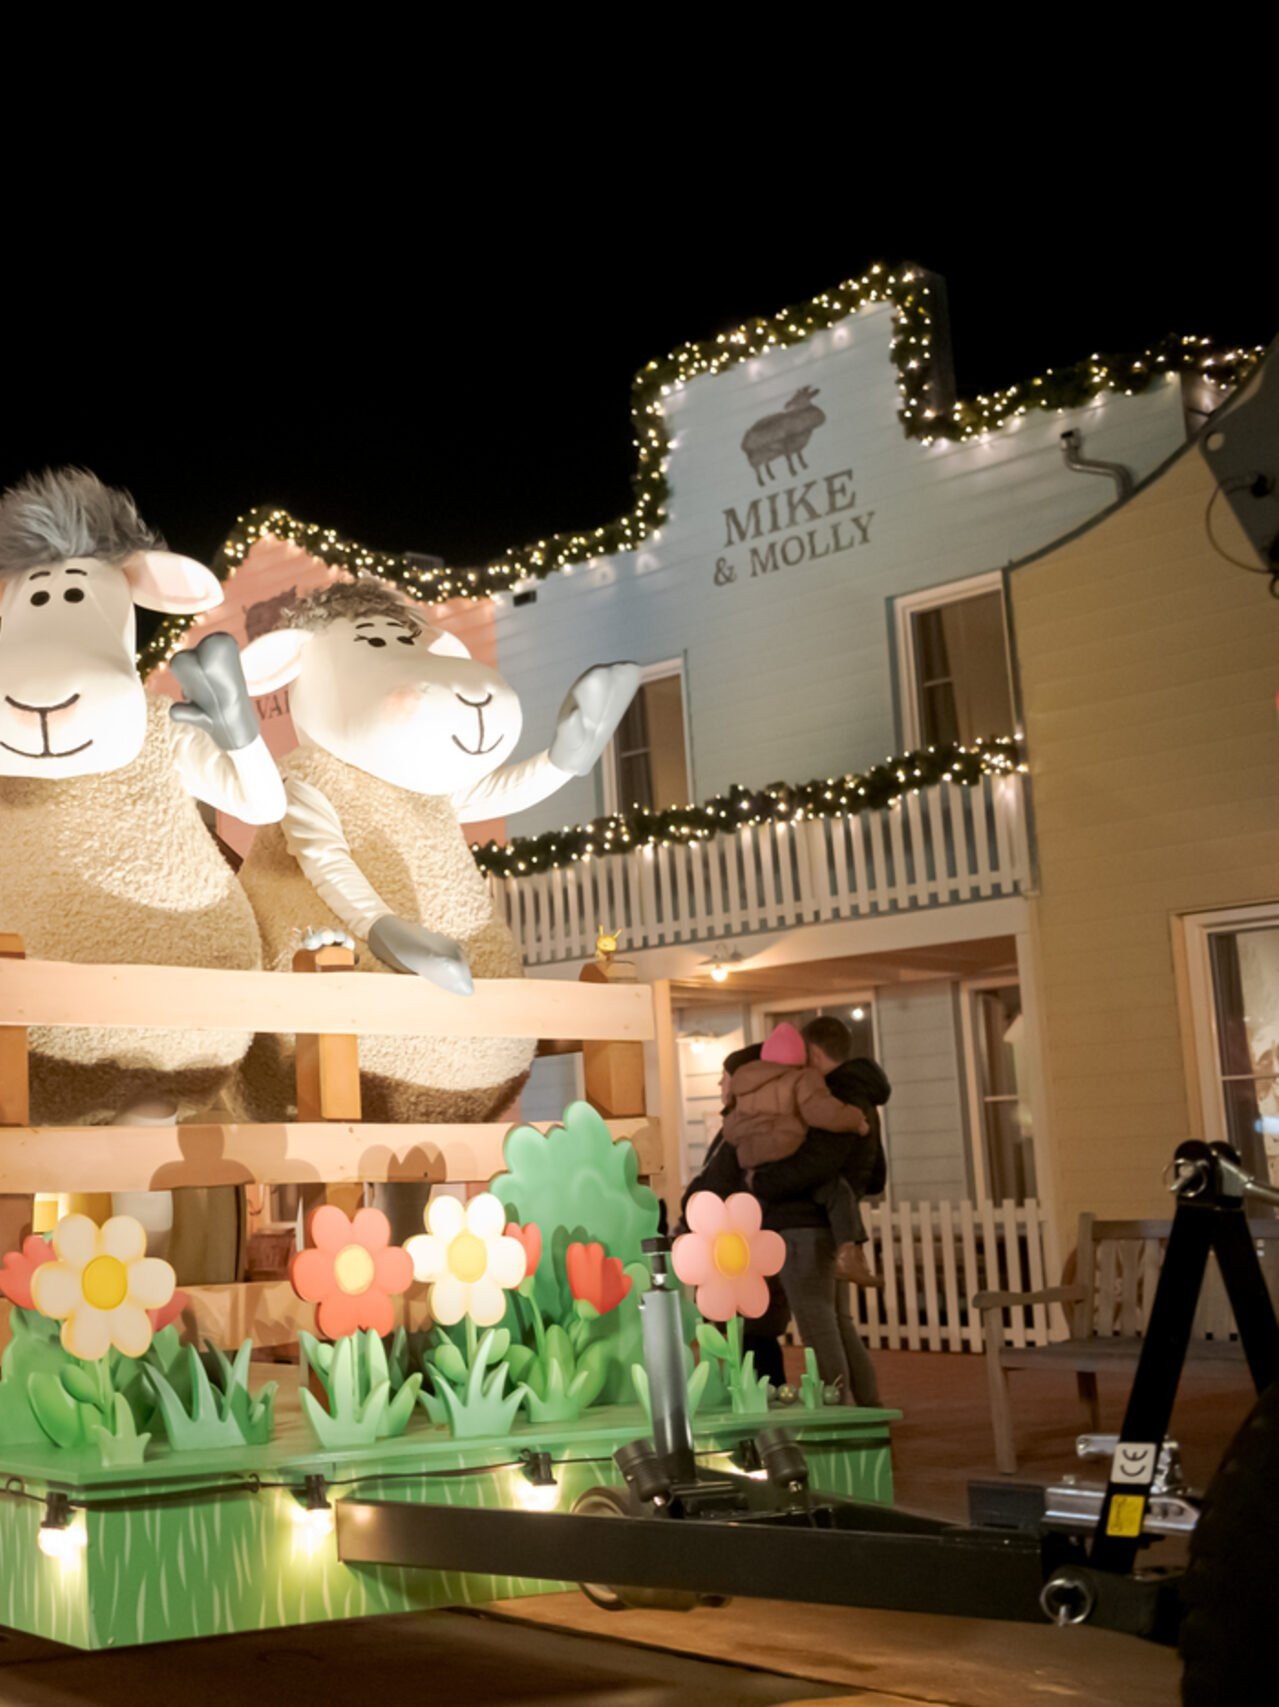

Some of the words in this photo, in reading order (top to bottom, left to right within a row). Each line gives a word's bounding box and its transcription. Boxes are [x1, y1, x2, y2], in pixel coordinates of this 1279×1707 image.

[722, 468, 857, 548] MIKE
[713, 556, 737, 587] &
[749, 509, 875, 578] MOLLY
